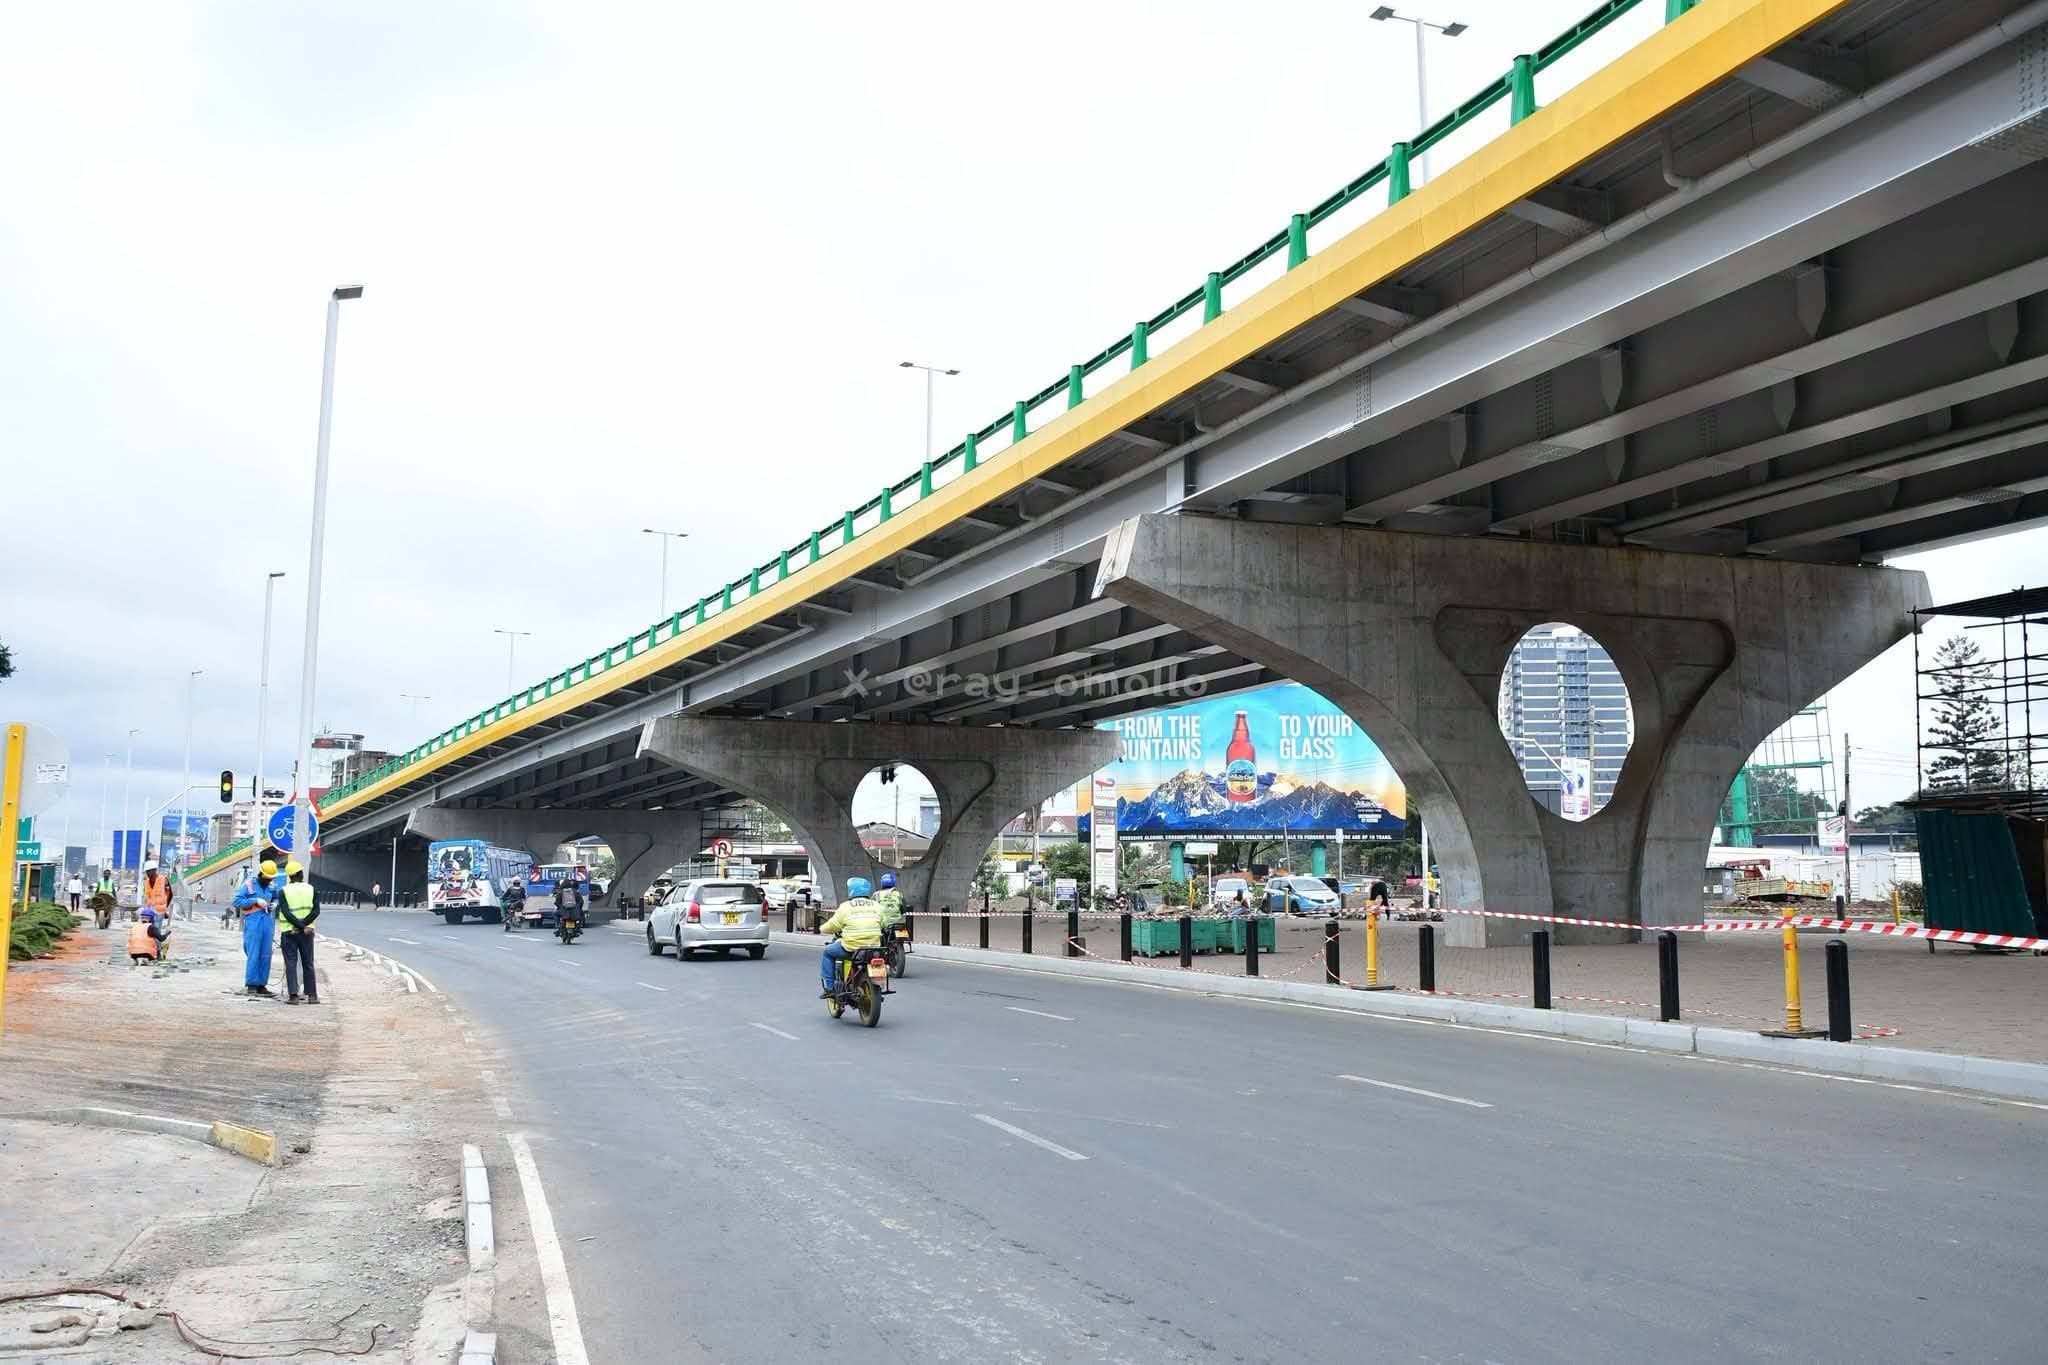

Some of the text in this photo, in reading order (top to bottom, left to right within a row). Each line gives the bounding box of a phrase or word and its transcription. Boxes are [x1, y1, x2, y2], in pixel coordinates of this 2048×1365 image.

[1114, 715, 1201, 738] FROM THE
[1280, 714, 1353, 737] TO YOUR
[1280, 737, 1335, 760] GLASS
[26, 847, 39, 855] Rd
